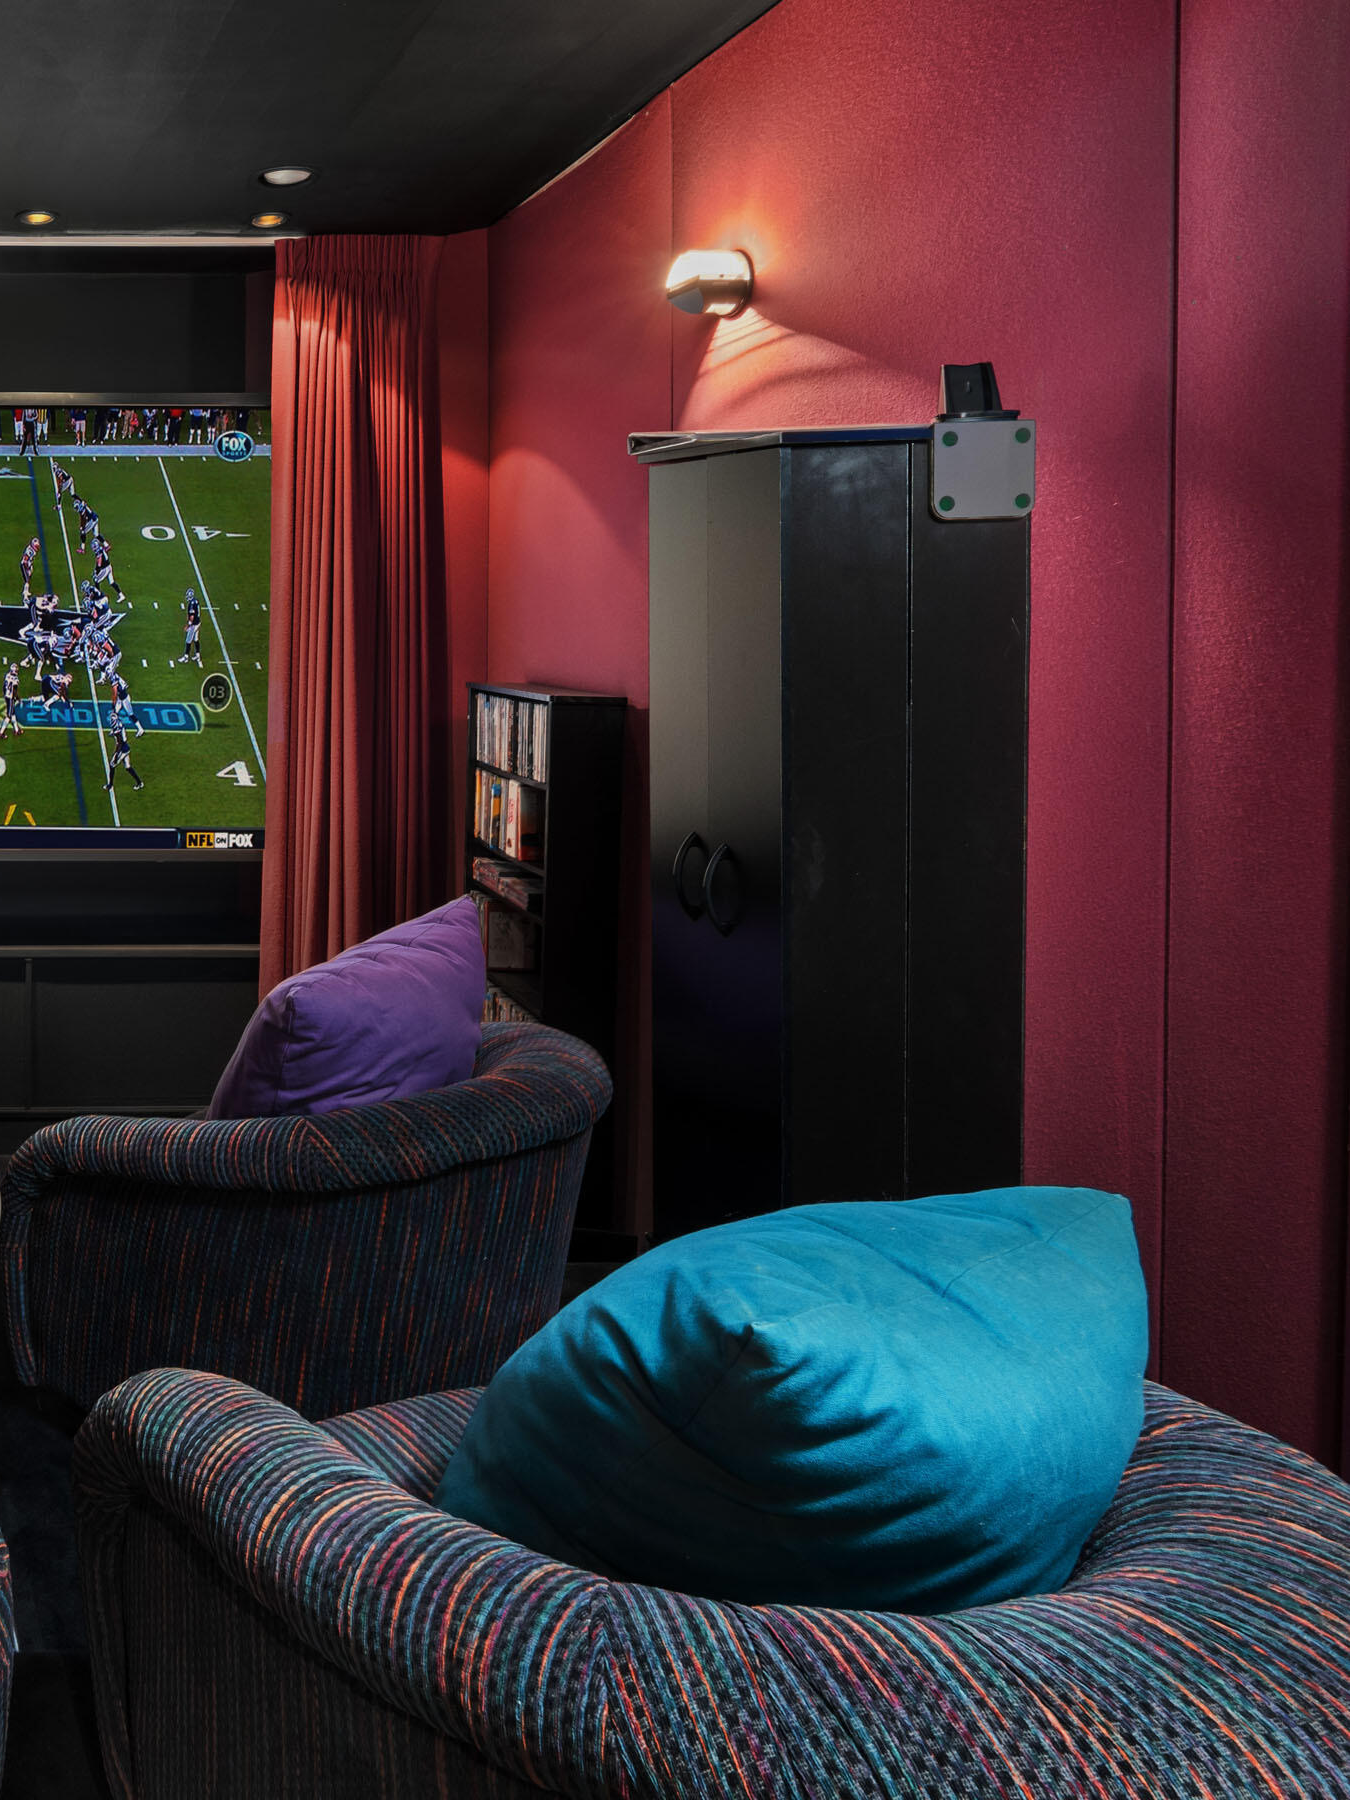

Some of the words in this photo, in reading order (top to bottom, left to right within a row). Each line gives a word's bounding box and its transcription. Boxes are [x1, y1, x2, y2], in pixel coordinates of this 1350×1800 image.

[222, 437, 247, 451] FOX
[209, 685, 226, 699] 03
[26, 703, 93, 723] 2ND
[143, 707, 187, 727] 10
[188, 833, 214, 847] NFL
[229, 833, 254, 847] FOX
